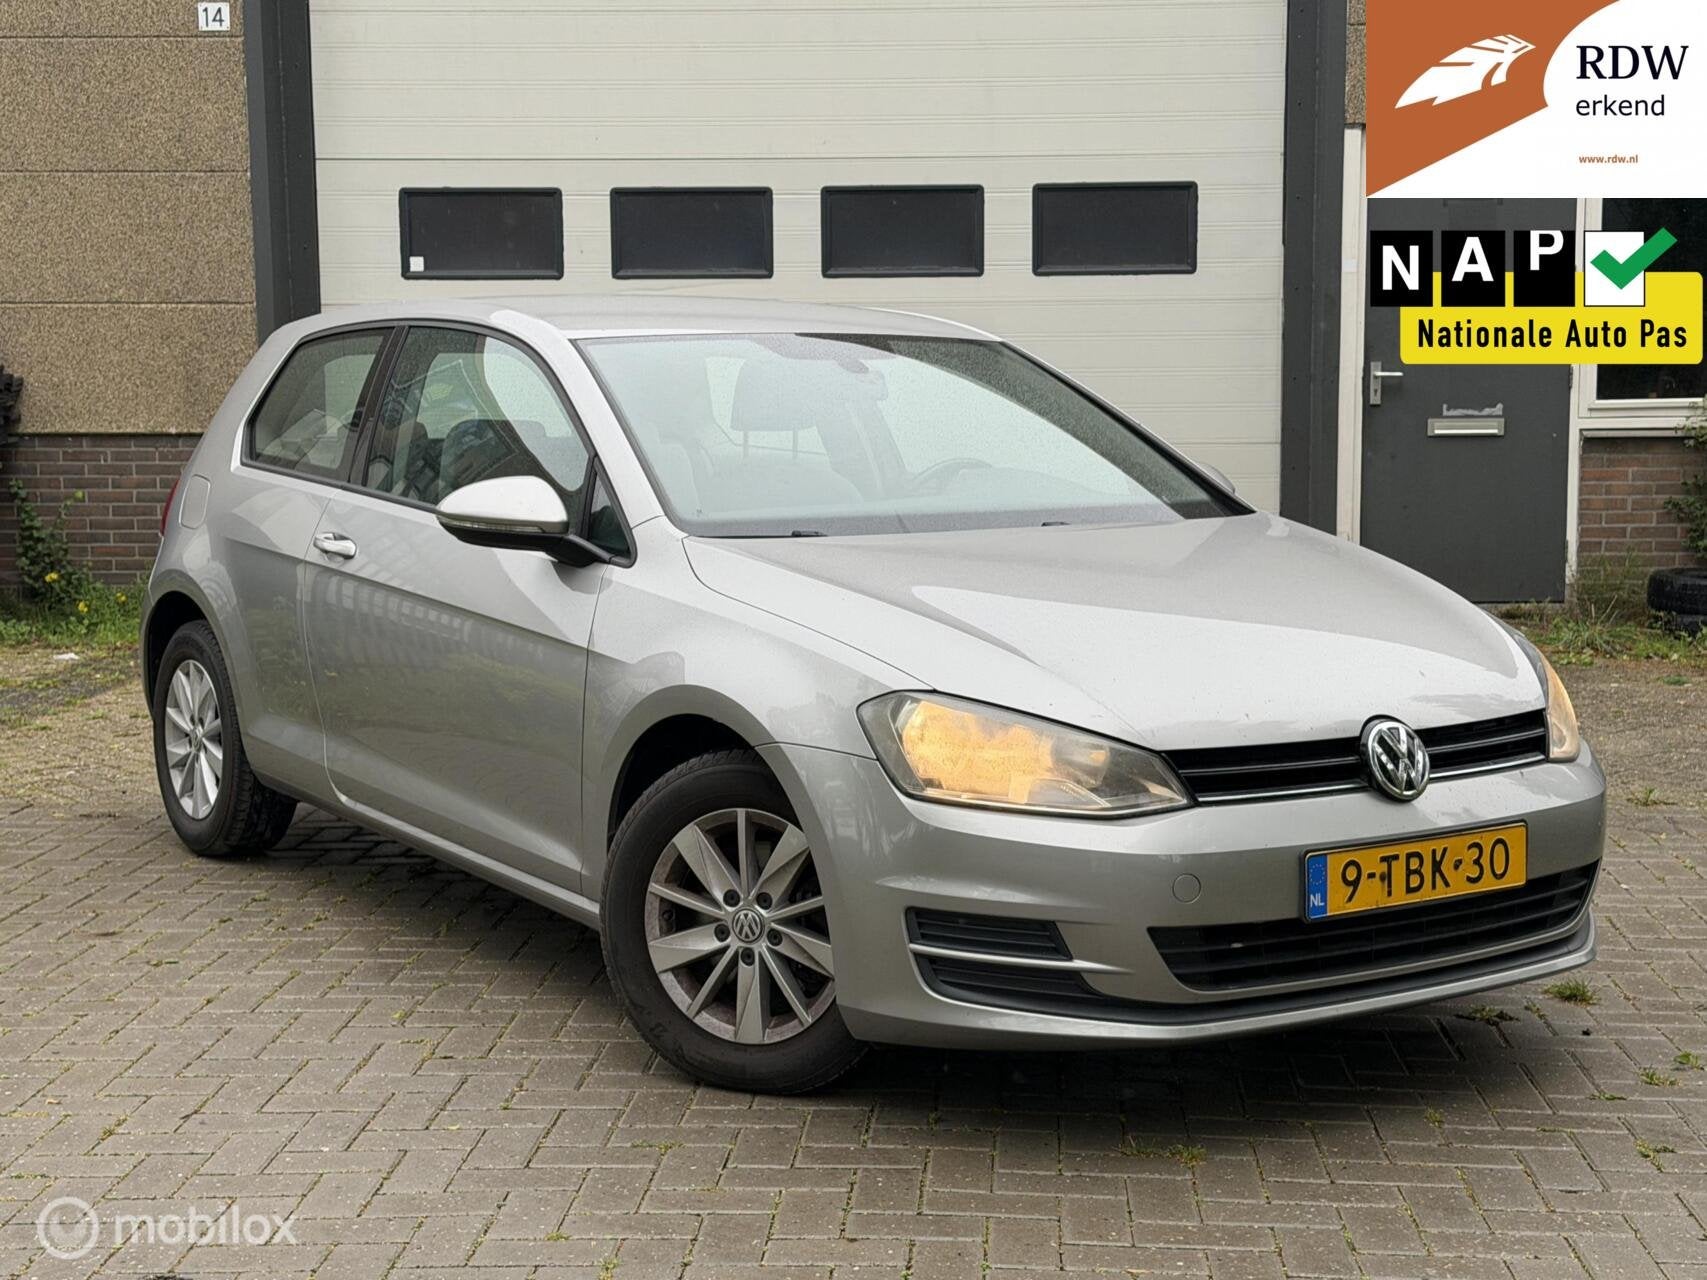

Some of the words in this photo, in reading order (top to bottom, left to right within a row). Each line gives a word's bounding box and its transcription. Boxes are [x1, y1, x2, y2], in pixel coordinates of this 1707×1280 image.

[202, 6, 225, 28] 14
[1340, 837, 1510, 904] 9-TBK-30
[1309, 893, 1325, 908] NL
